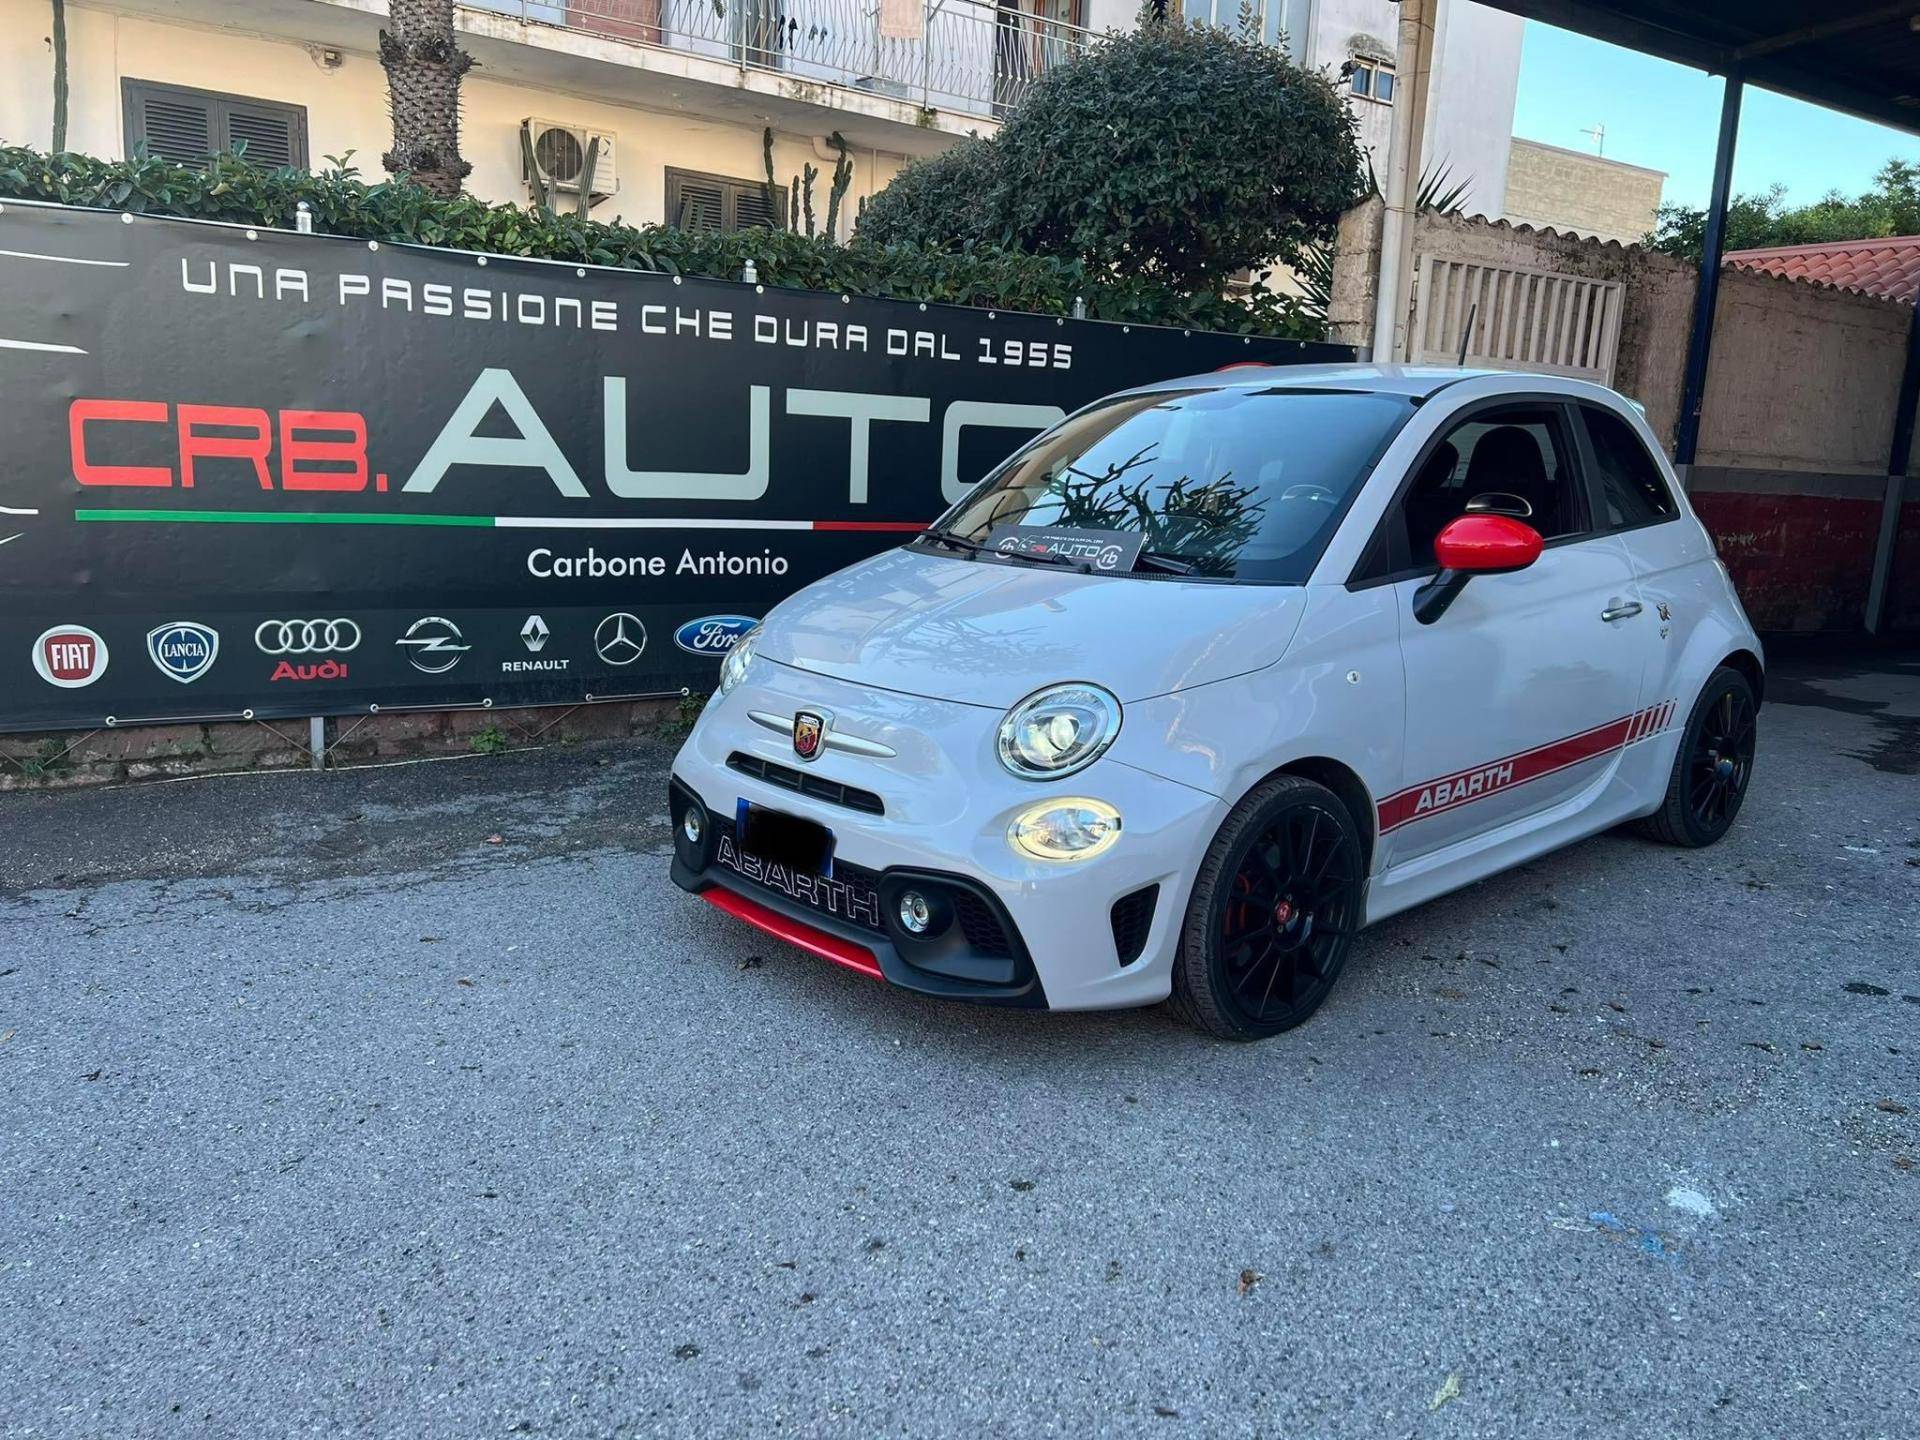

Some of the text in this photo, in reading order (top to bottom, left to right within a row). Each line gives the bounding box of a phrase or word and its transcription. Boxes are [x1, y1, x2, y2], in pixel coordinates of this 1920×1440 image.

[181, 257, 1073, 370] UNA PASSIONE CHE DURA DAL 1955
[527, 547, 789, 578] Carbone Antonio
[693, 621, 743, 649] For
[51, 643, 91, 671] FIAT
[164, 642, 205, 658] LANCIA
[269, 659, 349, 681] Audi
[502, 659, 570, 673] RENAULT
[1413, 761, 1515, 814] ABARTH
[717, 834, 880, 927] ABARTH
